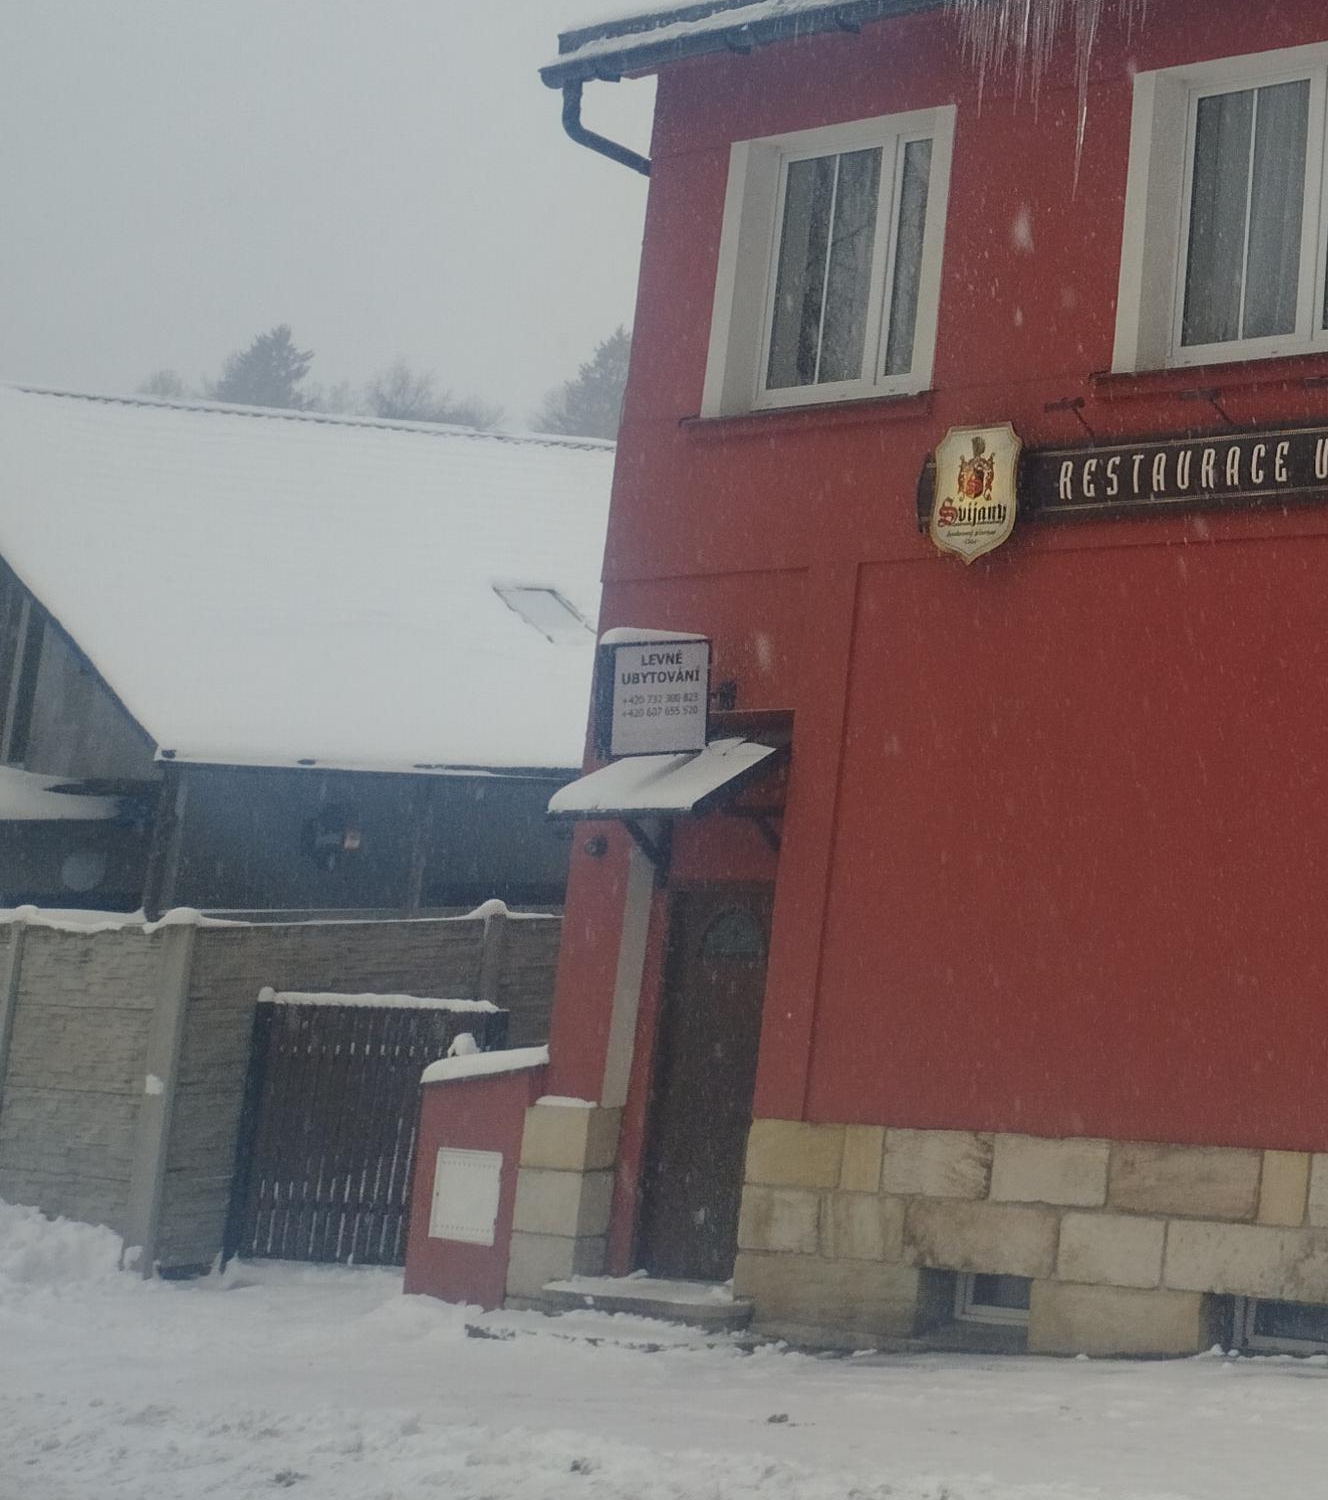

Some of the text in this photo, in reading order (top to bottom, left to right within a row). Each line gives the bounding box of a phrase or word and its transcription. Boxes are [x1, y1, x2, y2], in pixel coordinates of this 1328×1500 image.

[1059, 441, 1290, 500] RESTAURACE
[937, 496, 1007, 527] Svijany
[640, 650, 683, 666] LEVNÉ
[621, 666, 700, 685] UBYTOVÁNÍ
